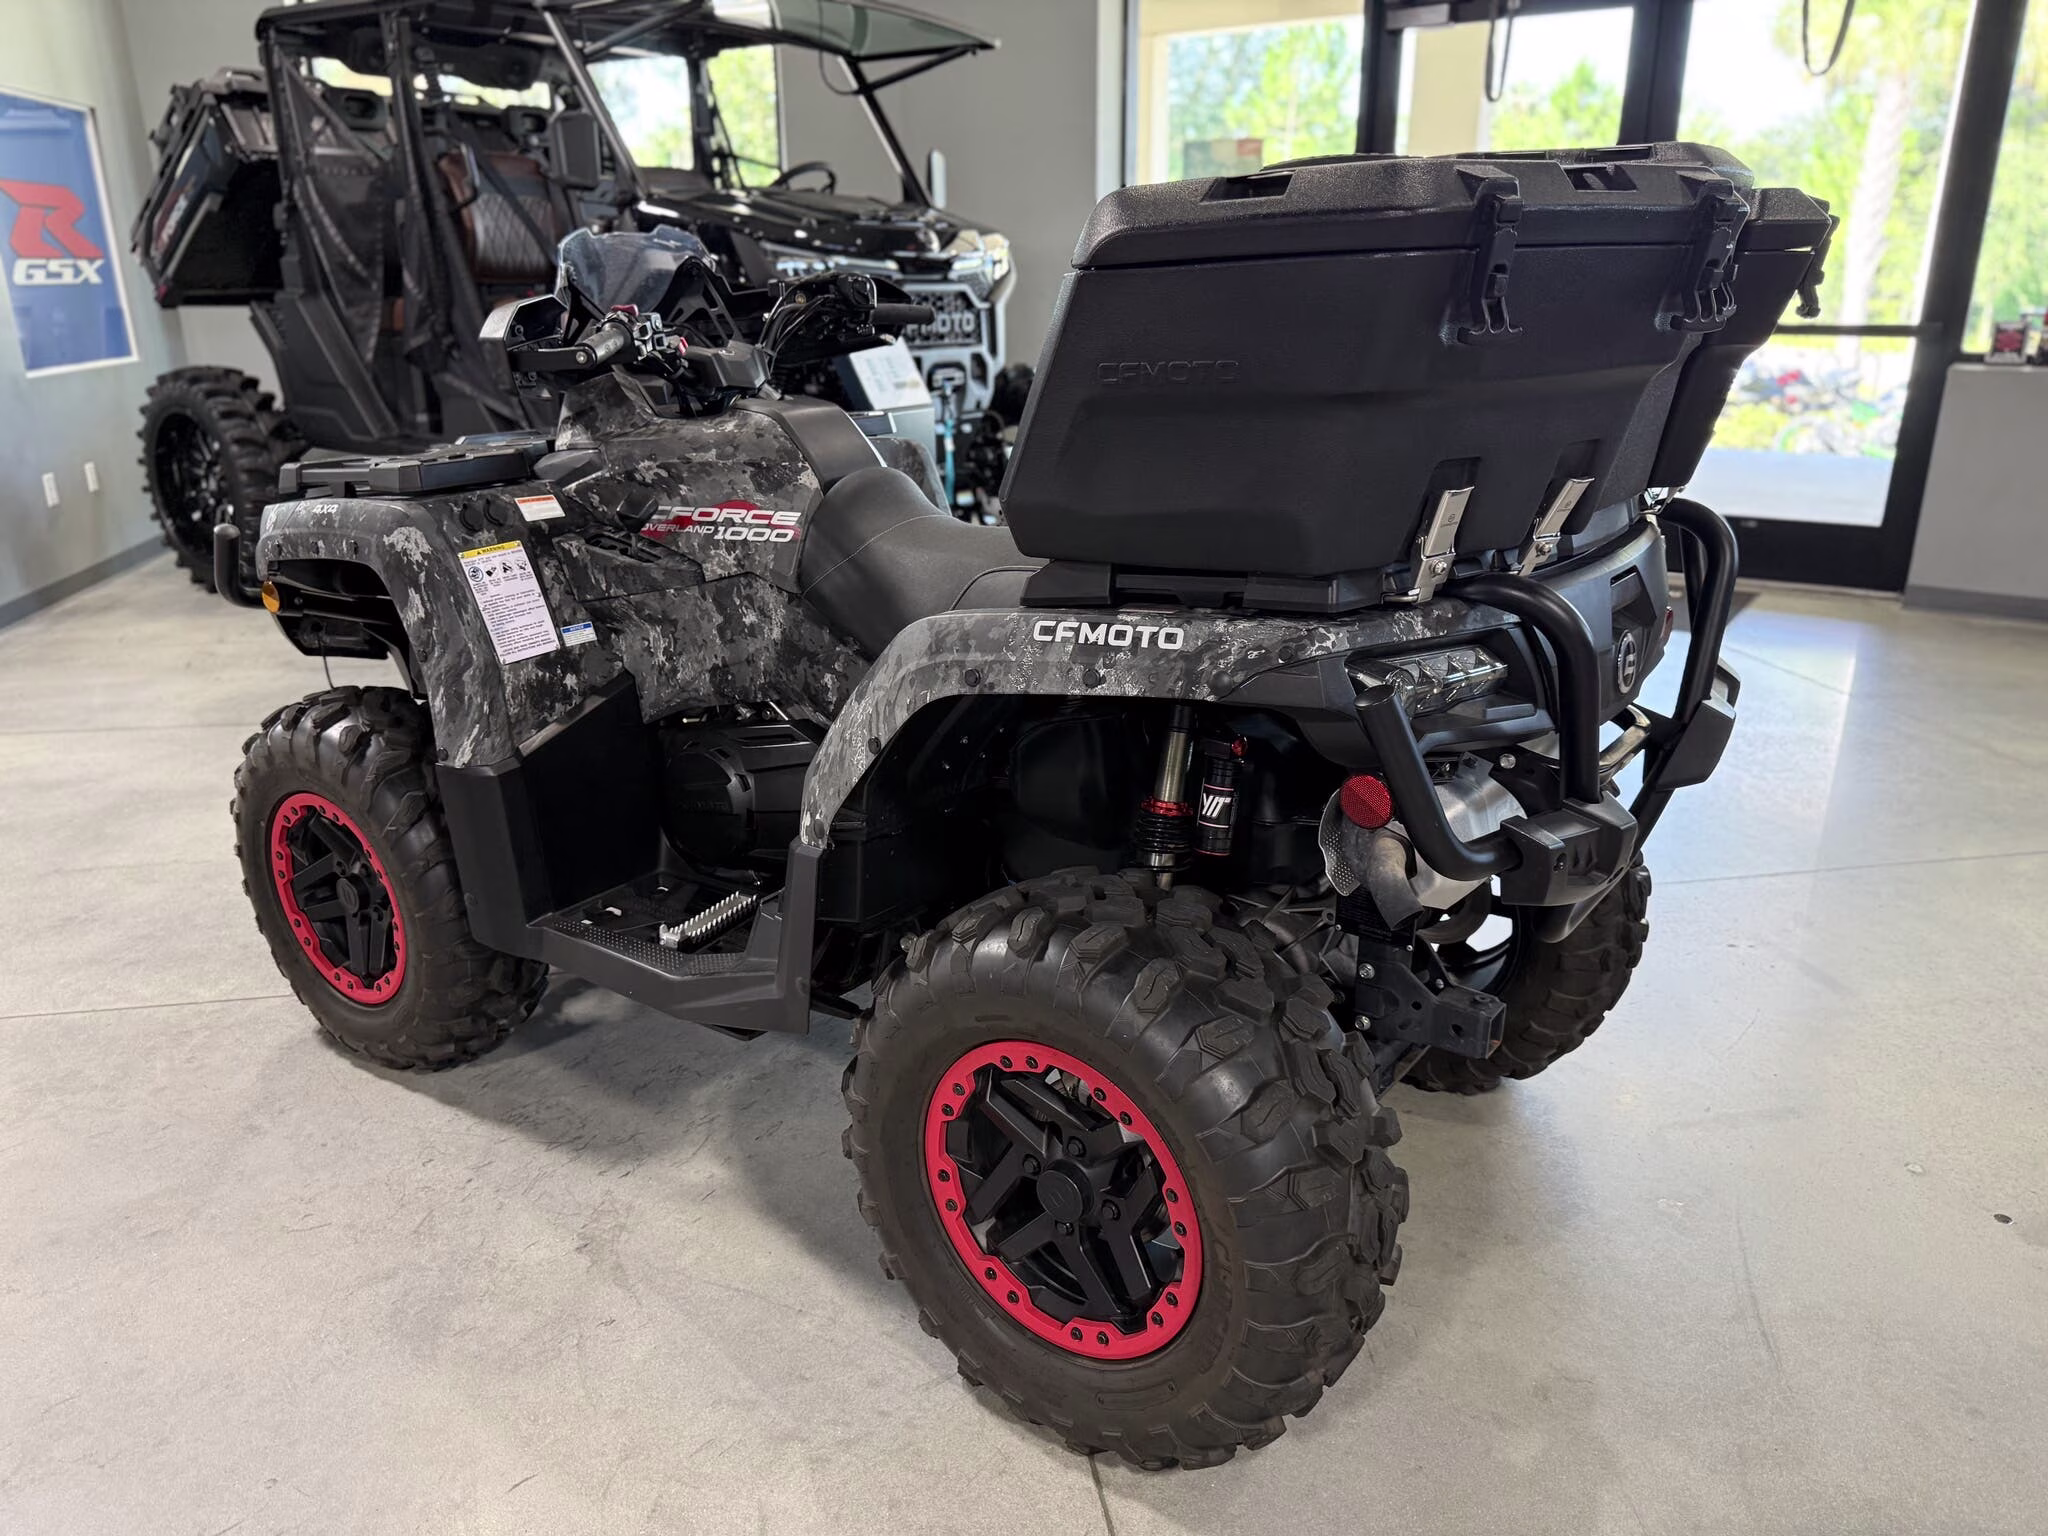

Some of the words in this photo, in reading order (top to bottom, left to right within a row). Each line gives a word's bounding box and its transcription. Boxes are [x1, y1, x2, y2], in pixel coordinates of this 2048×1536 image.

[0, 178, 104, 259] R
[13, 257, 104, 286] GSX
[482, 545, 505, 553] WARNING
[713, 526, 796, 543] 1000
[1033, 620, 1185, 650] CFMOTO
